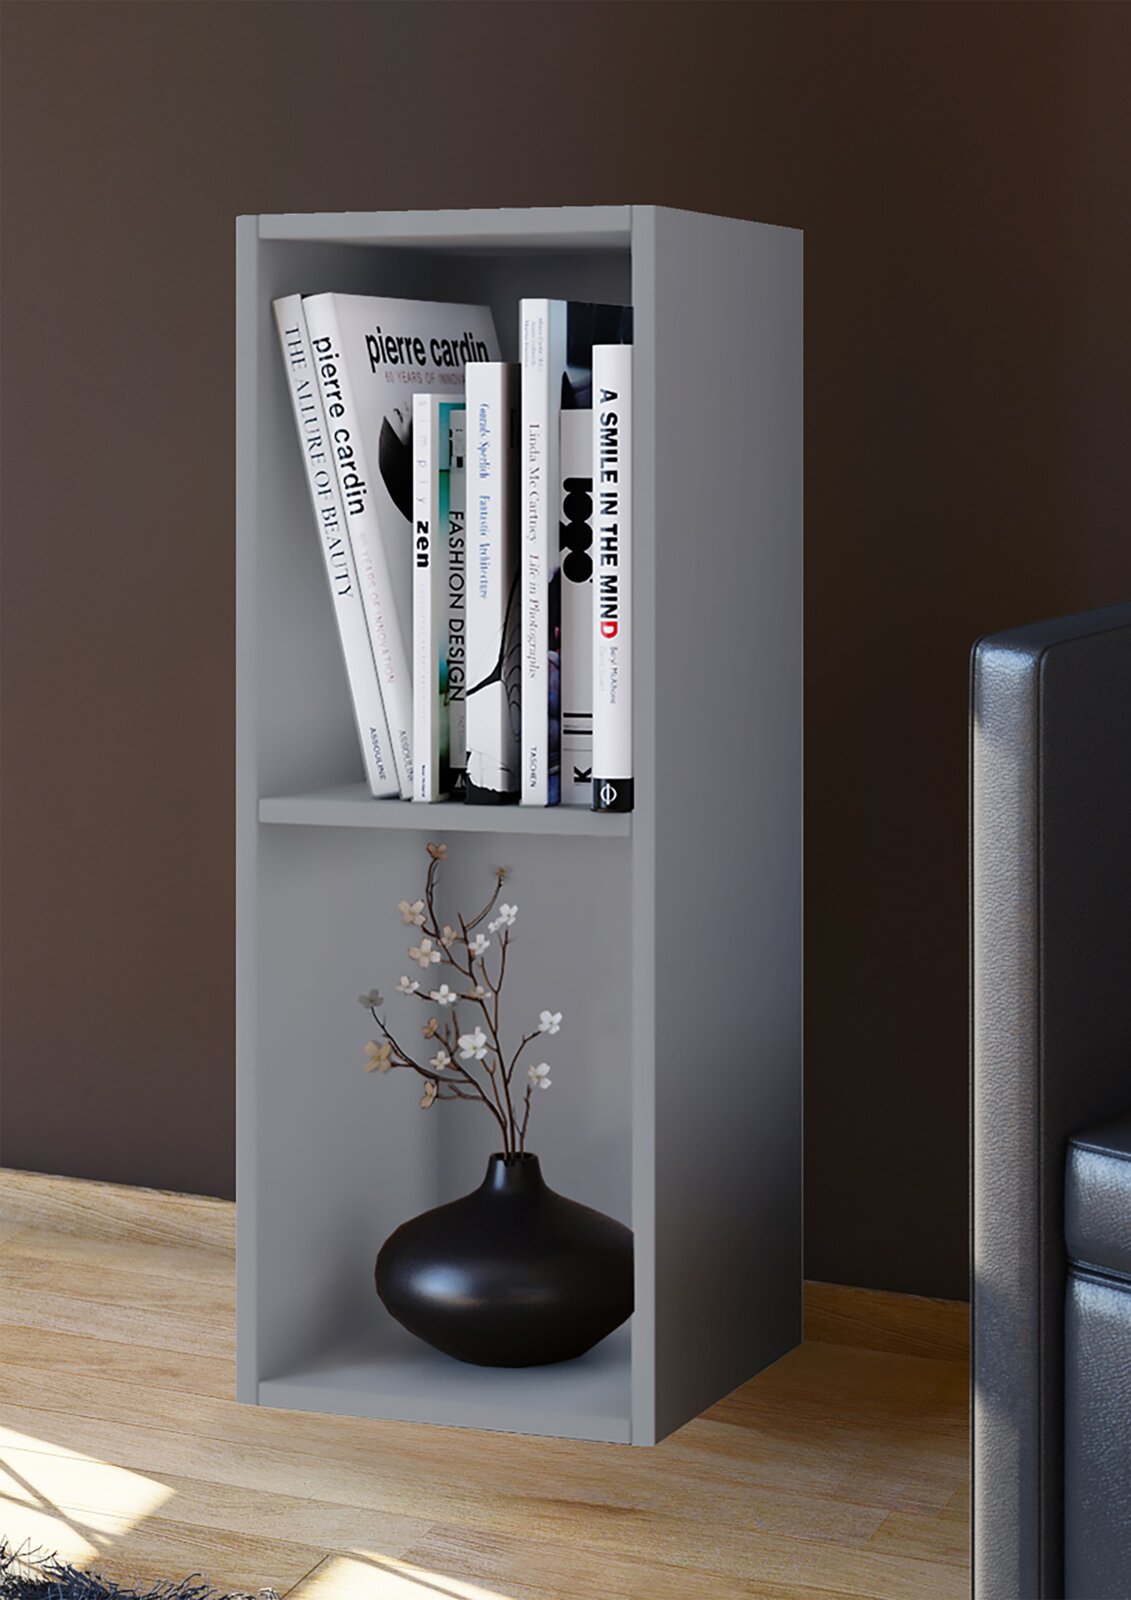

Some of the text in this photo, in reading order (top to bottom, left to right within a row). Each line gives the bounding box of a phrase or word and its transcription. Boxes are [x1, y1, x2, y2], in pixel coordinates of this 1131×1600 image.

[365, 325, 426, 374] pierre
[429, 331, 490, 367] cardin
[396, 370, 422, 384] YEARS
[424, 371, 435, 385] OF
[284, 322, 354, 598] THE ALLURE OF BEAUTY
[312, 336, 367, 515] pierre cardin
[528, 424, 541, 462] Linda
[416, 521, 429, 567] zen
[600, 388, 619, 639] A SMILE IN THE MIND
[448, 511, 465, 609] FASHION
[374, 610, 395, 684] INNOVATION
[526, 554, 541, 679] Life in Photographs
[448, 619, 465, 702] DESIGN
[529, 747, 538, 788] TASCHEN
